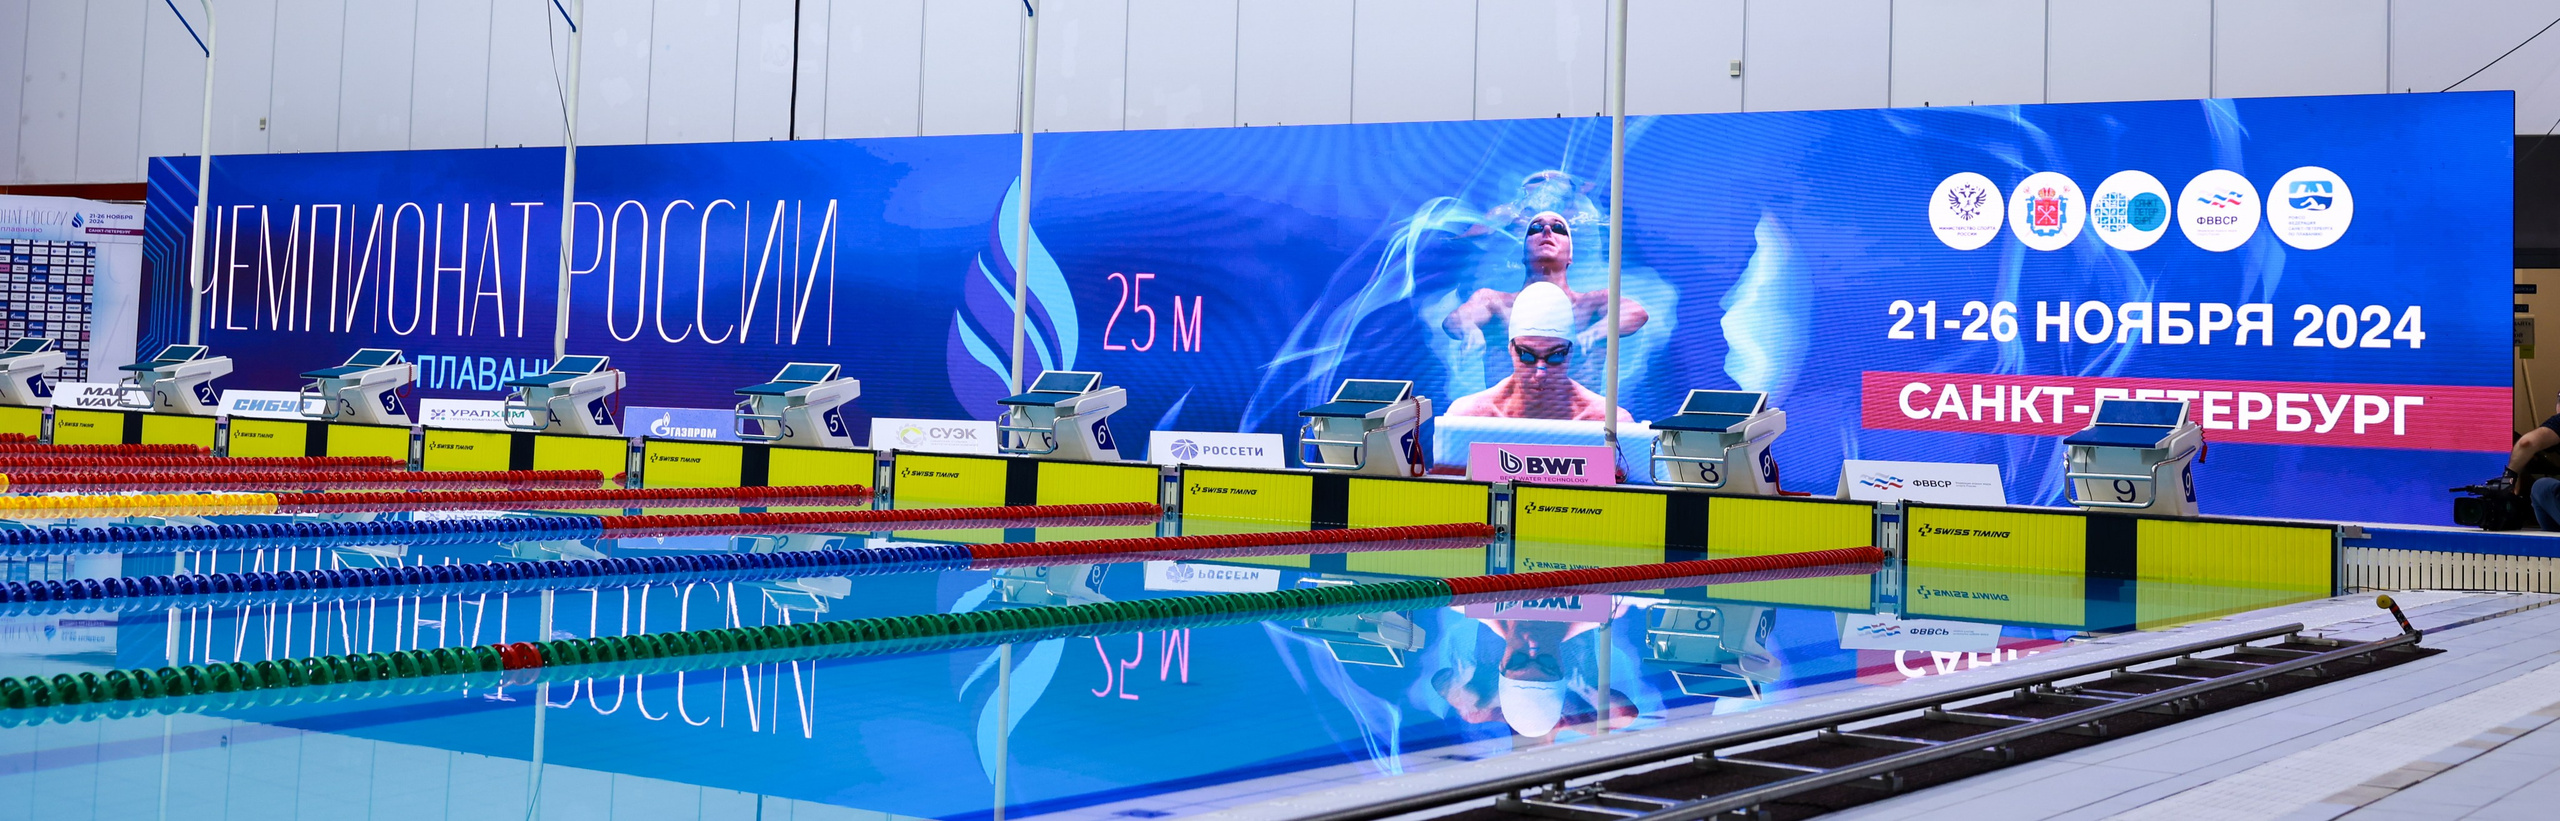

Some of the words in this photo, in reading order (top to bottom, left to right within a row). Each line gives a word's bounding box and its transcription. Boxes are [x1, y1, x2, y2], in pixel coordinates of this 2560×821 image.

[2196, 216, 2238, 225] ФВВСР
[190, 201, 544, 339] ЧЕМПИОНАТ
[565, 198, 838, 346] РОССИИ
[1103, 272, 1156, 352] 25
[1887, 299, 2018, 343] 21-26
[2036, 300, 2273, 346] НОЯБРЯ
[2293, 303, 2426, 349] 2024
[36, 380, 42, 394] 1
[201, 387, 211, 403] 2
[386, 395, 395, 411] 3
[1899, 381, 2424, 436] САНКТ-ЕРБУРГ
[595, 407, 603, 424] 4
[829, 414, 839, 432] 5
[670, 427, 717, 438] ГАЗПРОМ
[929, 427, 978, 440] СУЭК
[1097, 425, 1107, 444] 6
[1203, 445, 1264, 457] РОССЕТИ
[1406, 438, 1414, 459] 7
[1525, 456, 1587, 476] BWT
[1698, 462, 1719, 483] 8
[1763, 454, 1771, 477] 8
[1912, 479, 1952, 488] ФВВСР
[2113, 479, 2136, 503] 9
[2185, 473, 2192, 497] 9
[1571, 507, 1603, 515] TIMING
[1934, 527, 1971, 536] SWISS
[1972, 529, 2010, 538] TIMING
